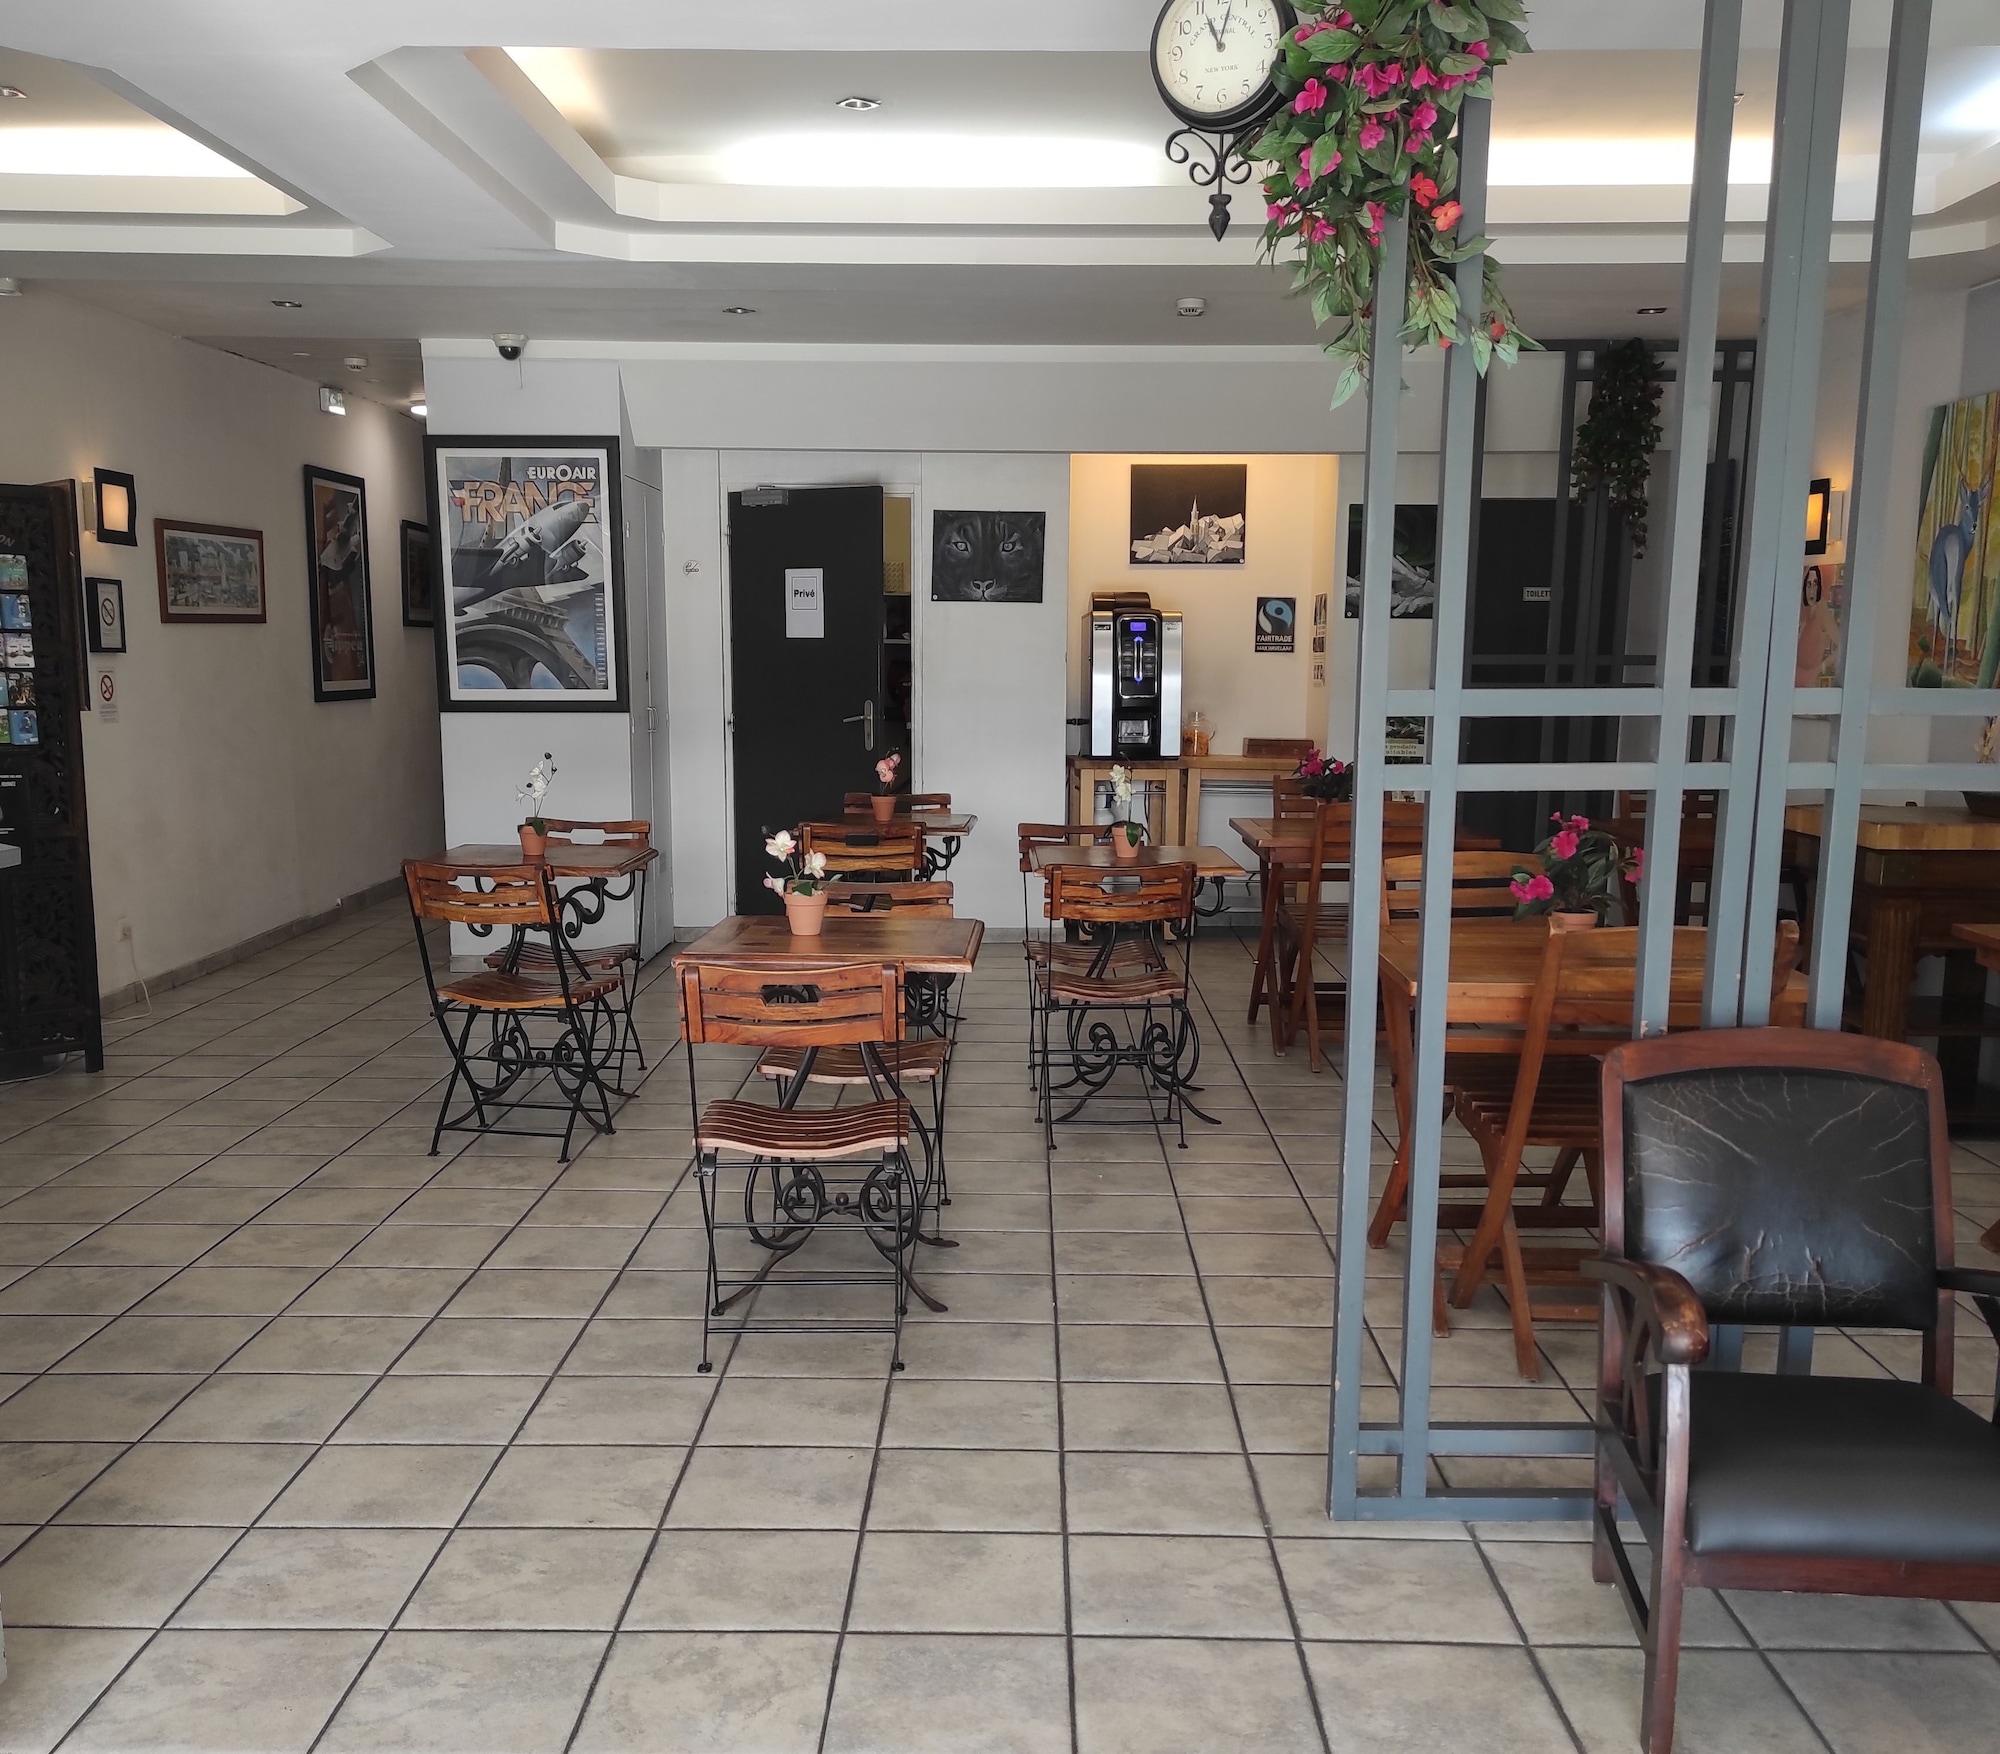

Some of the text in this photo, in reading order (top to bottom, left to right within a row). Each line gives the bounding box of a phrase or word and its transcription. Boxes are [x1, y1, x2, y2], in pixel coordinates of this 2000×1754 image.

[1258, 9, 1267, 24] 2
[1179, 20, 1192, 36] 10
[1263, 33, 1273, 49] 3
[1172, 46, 1183, 61] 9
[1256, 59, 1267, 74] 4
[1179, 69, 1188, 84] 8
[1195, 85, 1203, 100] 7
[1216, 88, 1227, 103] 6
[1241, 79, 1250, 97] 5
[527, 464, 596, 482] EUROAIR
[450, 480, 599, 523] FRANCE
[794, 588, 815, 598] Privé
